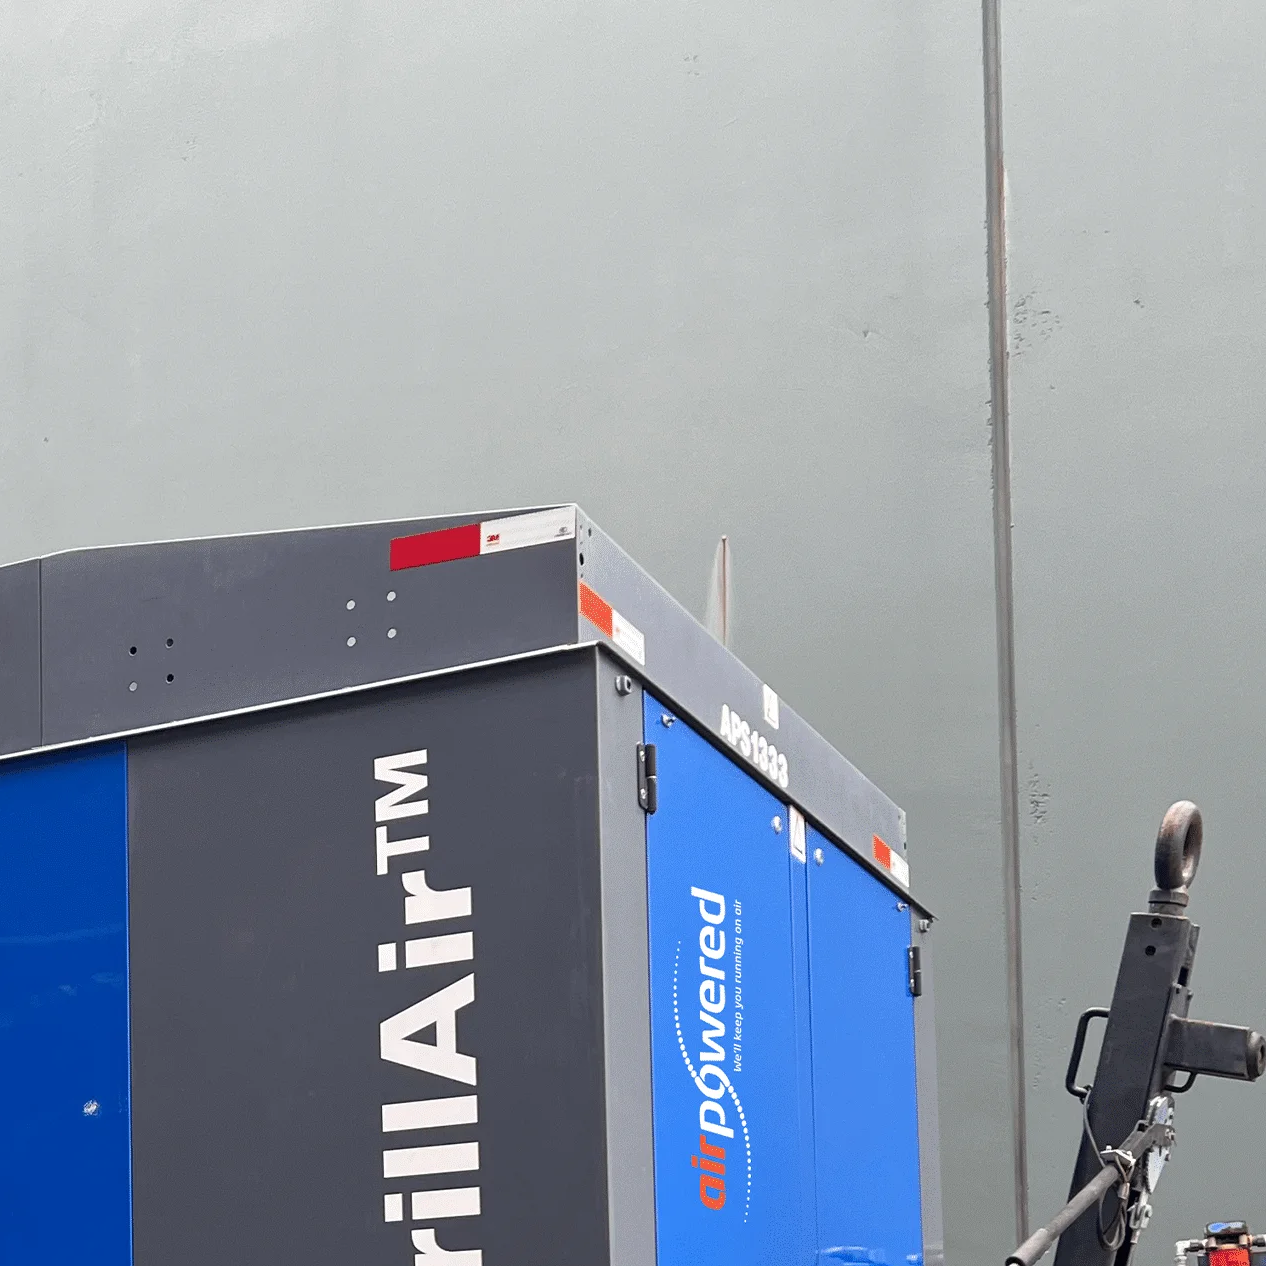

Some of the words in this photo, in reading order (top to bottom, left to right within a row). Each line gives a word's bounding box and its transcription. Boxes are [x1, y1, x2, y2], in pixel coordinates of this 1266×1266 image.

[734, 899, 742, 915] air
[734, 918, 742, 934] on
[733, 937, 744, 984] running
[734, 986, 744, 1010] you
[733, 1012, 744, 1041] keep
[690, 887, 734, 1210] airpowered
[733, 1043, 742, 1072] We'll
